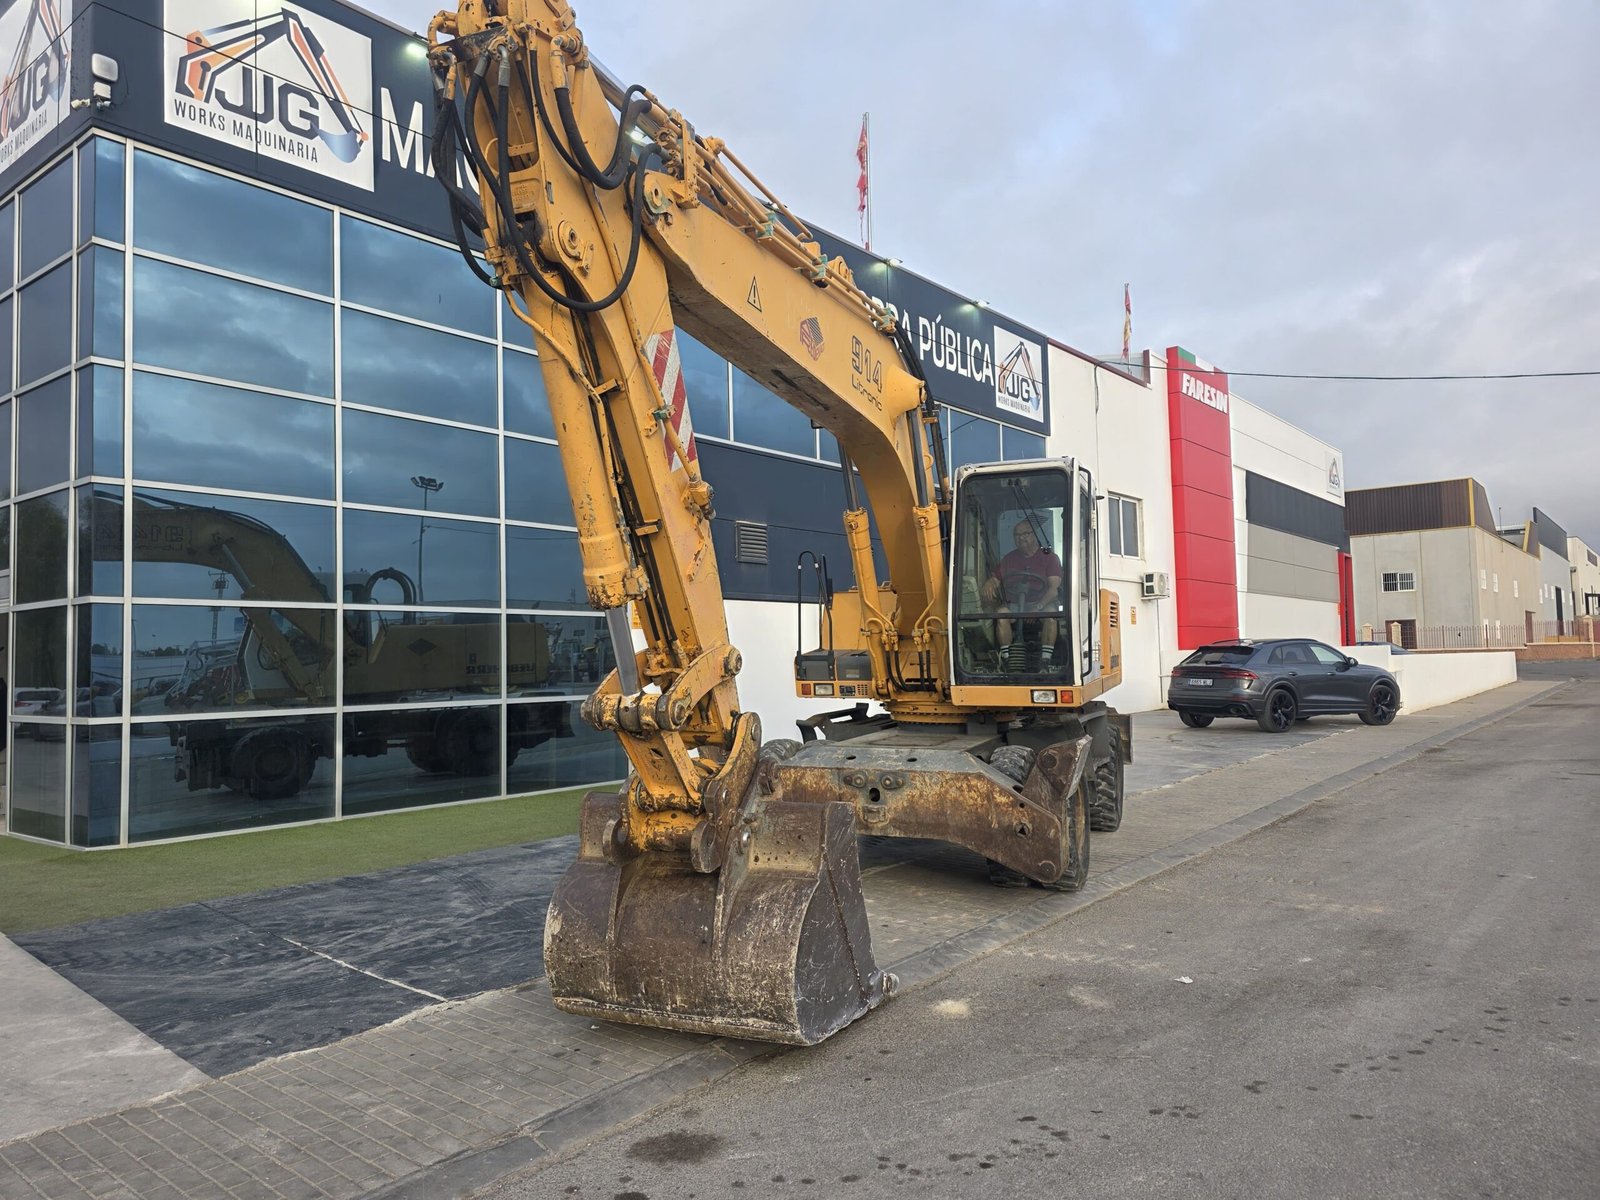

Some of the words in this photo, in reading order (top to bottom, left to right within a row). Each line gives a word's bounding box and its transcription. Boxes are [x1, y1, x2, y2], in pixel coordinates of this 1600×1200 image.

[173, 98, 226, 132] WORKS
[233, 119, 319, 163] MAQUINARIA
[215, 65, 320, 140] JJG
[851, 335, 883, 393] 914
[918, 314, 995, 386] PÚBLICA
[851, 374, 883, 411] Litronic
[1006, 374, 1031, 403] JJG
[1181, 373, 1228, 414] FARESIN
